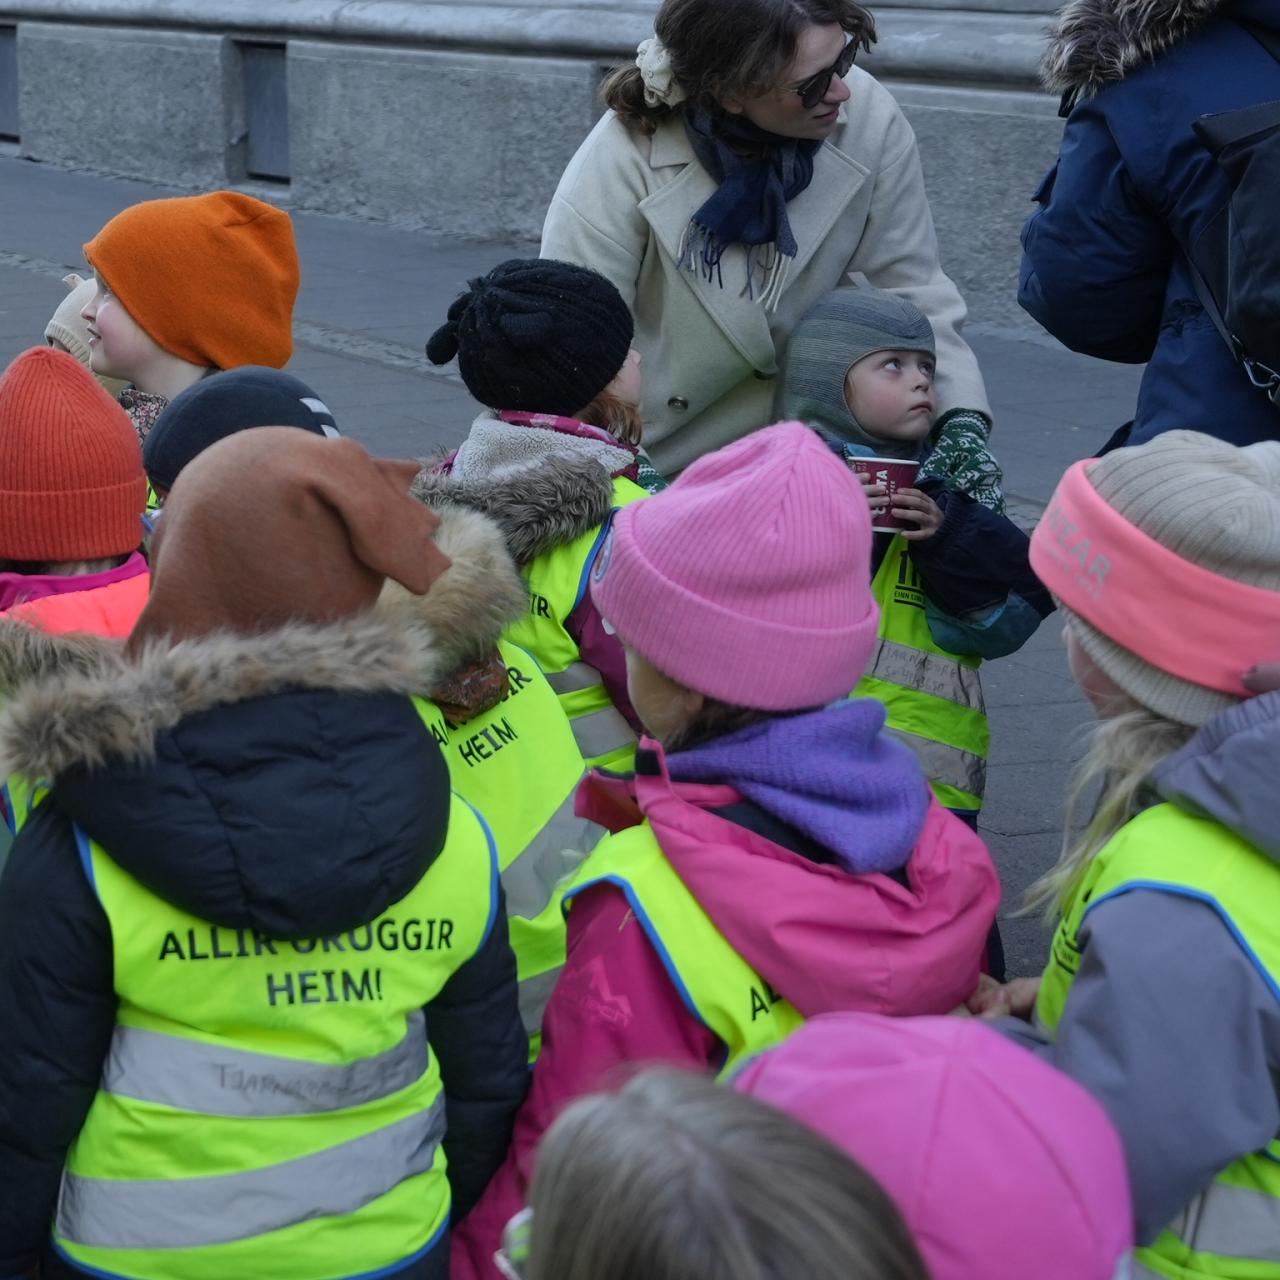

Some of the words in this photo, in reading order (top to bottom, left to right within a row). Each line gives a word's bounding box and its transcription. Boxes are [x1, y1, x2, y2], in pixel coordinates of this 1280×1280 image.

[871, 469, 889, 517] CTA
[159, 925, 278, 961] ALLIR
[266, 968, 384, 1007] HEIM!
